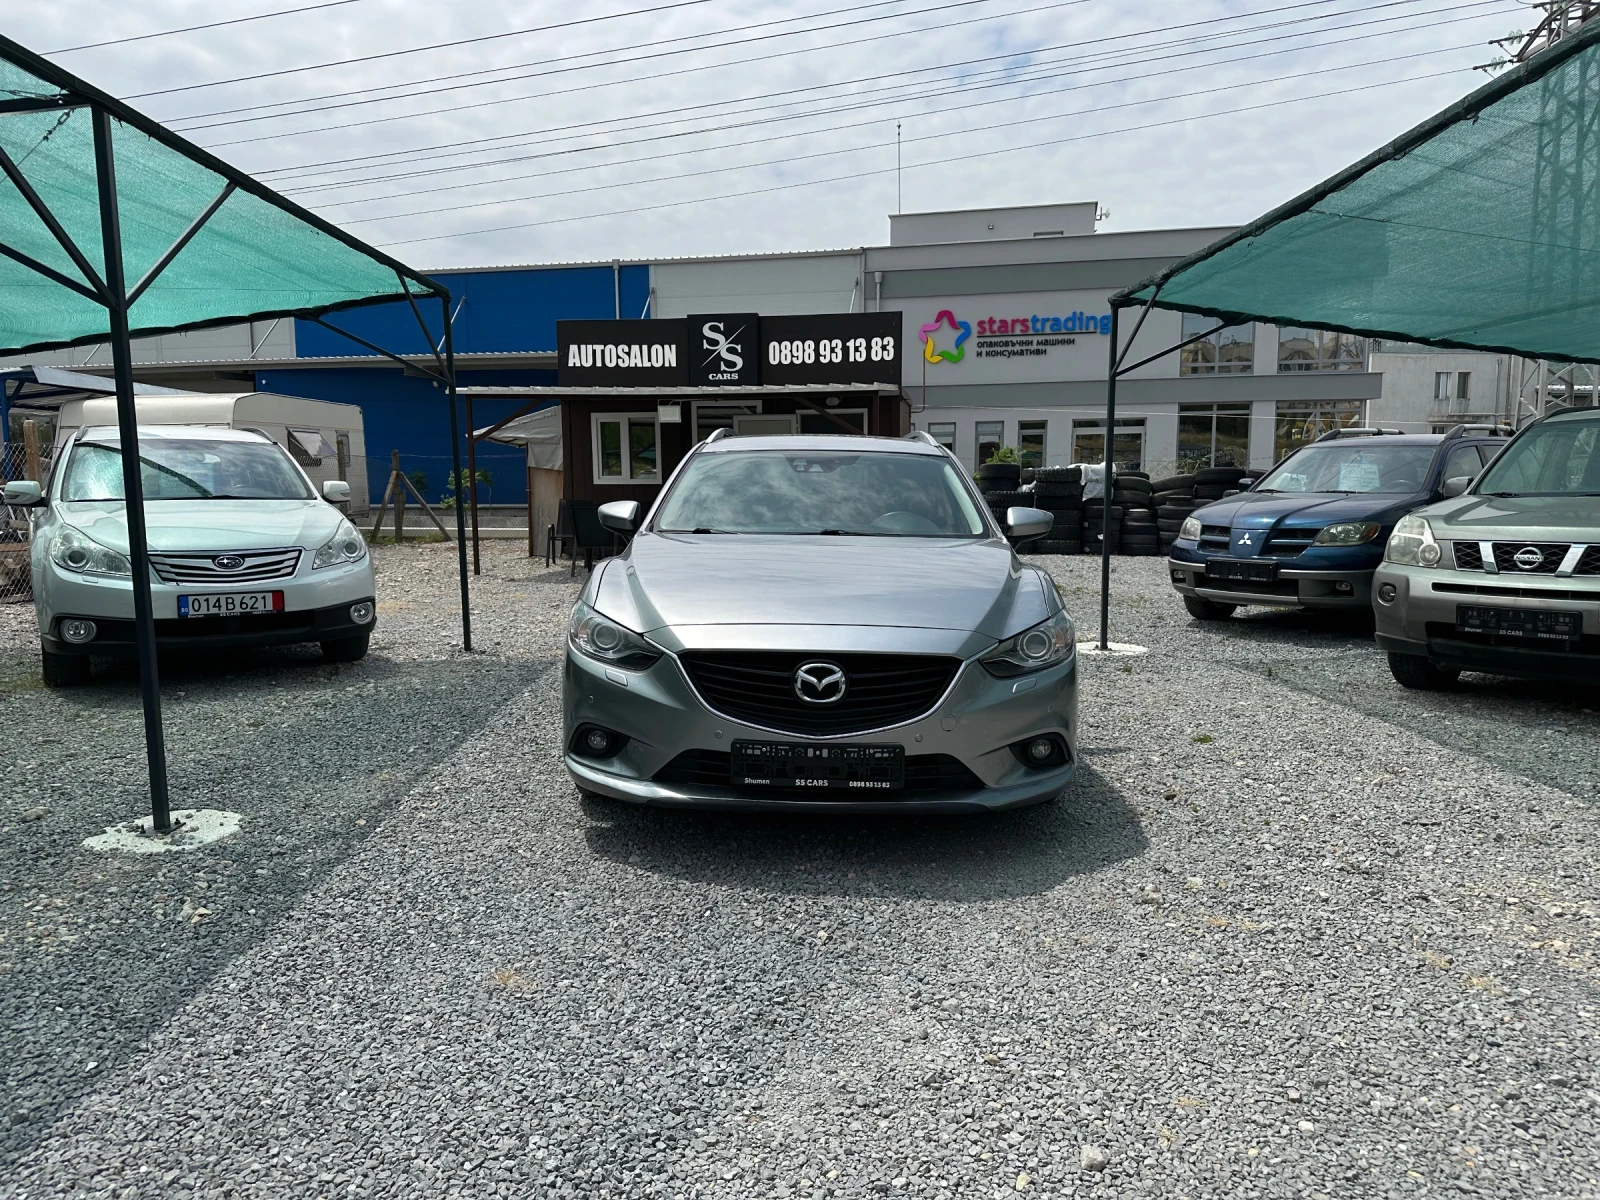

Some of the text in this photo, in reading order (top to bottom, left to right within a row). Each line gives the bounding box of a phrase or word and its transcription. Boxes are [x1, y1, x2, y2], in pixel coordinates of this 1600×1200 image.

[768, 336, 895, 365] 0898 93 13 83
[976, 338, 1076, 348] опаковъчни машини
[567, 344, 677, 368] AUTOSALON
[976, 348, 1047, 358] и консумативи
